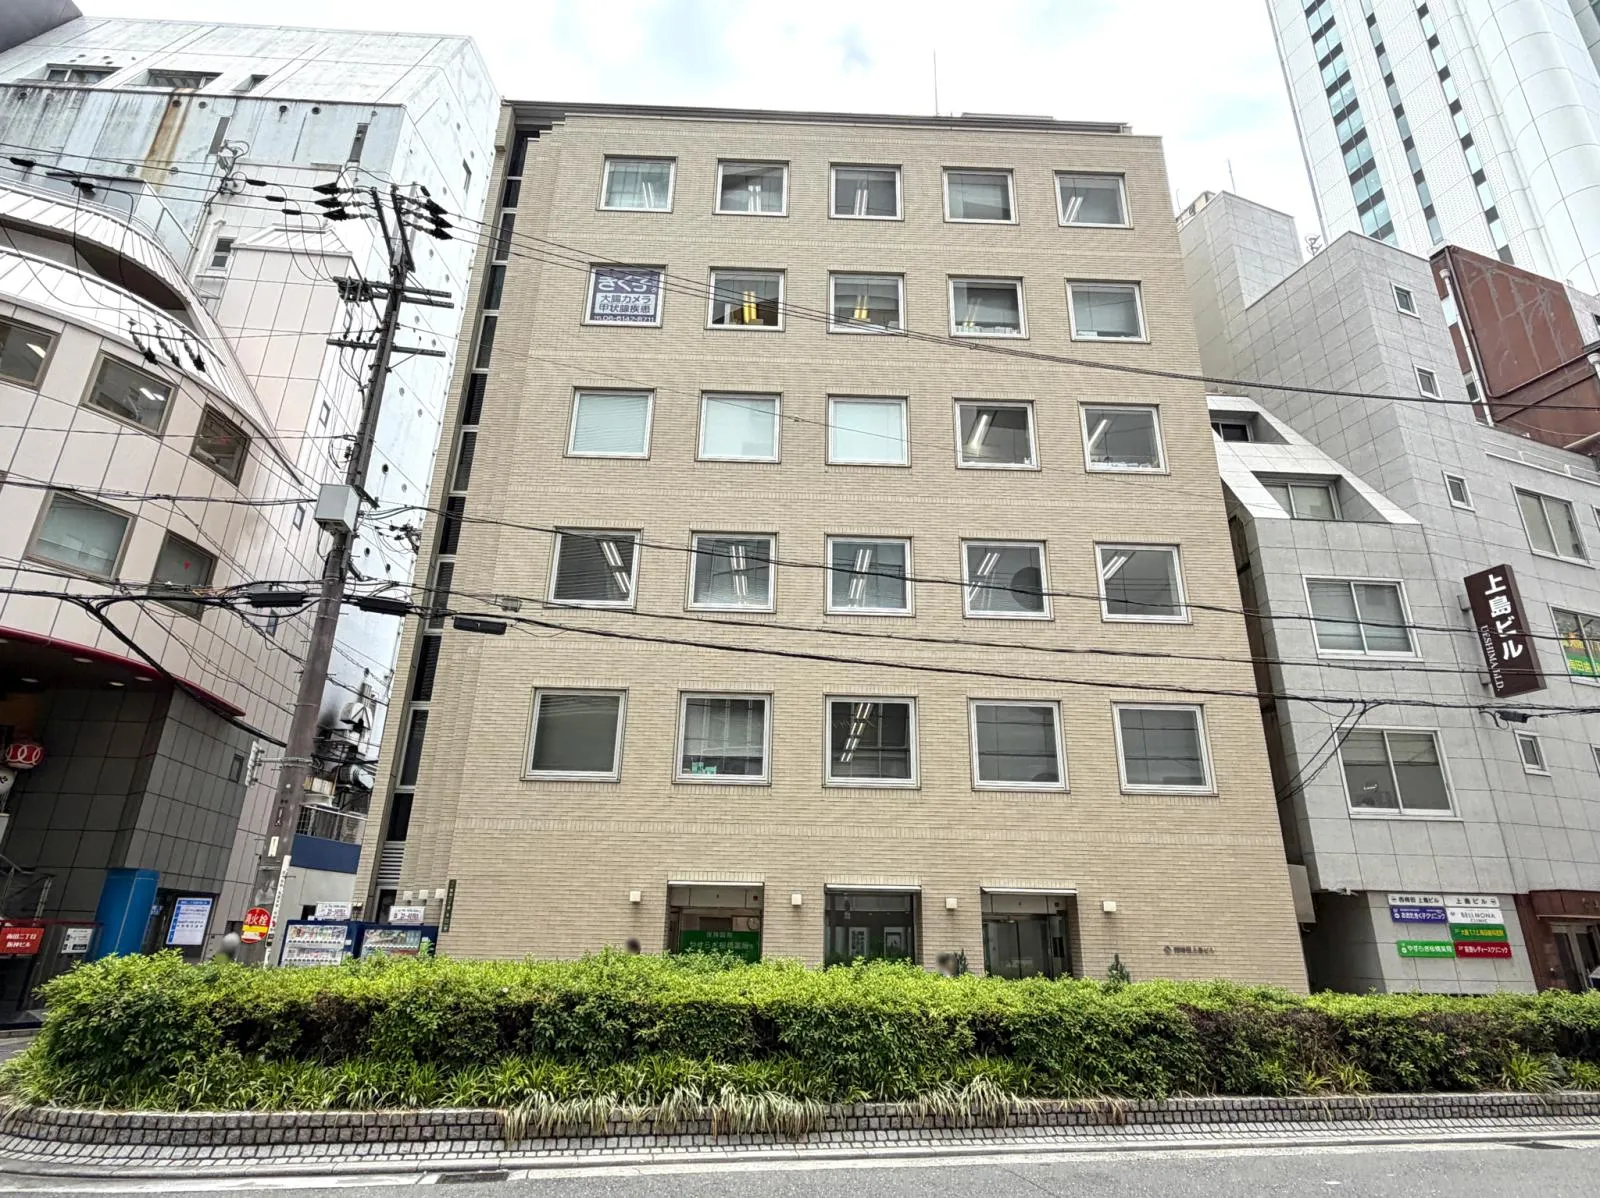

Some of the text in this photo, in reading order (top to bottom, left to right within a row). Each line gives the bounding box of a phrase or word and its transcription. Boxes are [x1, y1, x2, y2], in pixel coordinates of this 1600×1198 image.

[598, 304, 651, 314] 甲状腺疾患
[600, 294, 652, 304] 大腸カメラ
[1484, 573, 1523, 661] 上島ビル
[1479, 625, 1499, 669] UESHIMA
